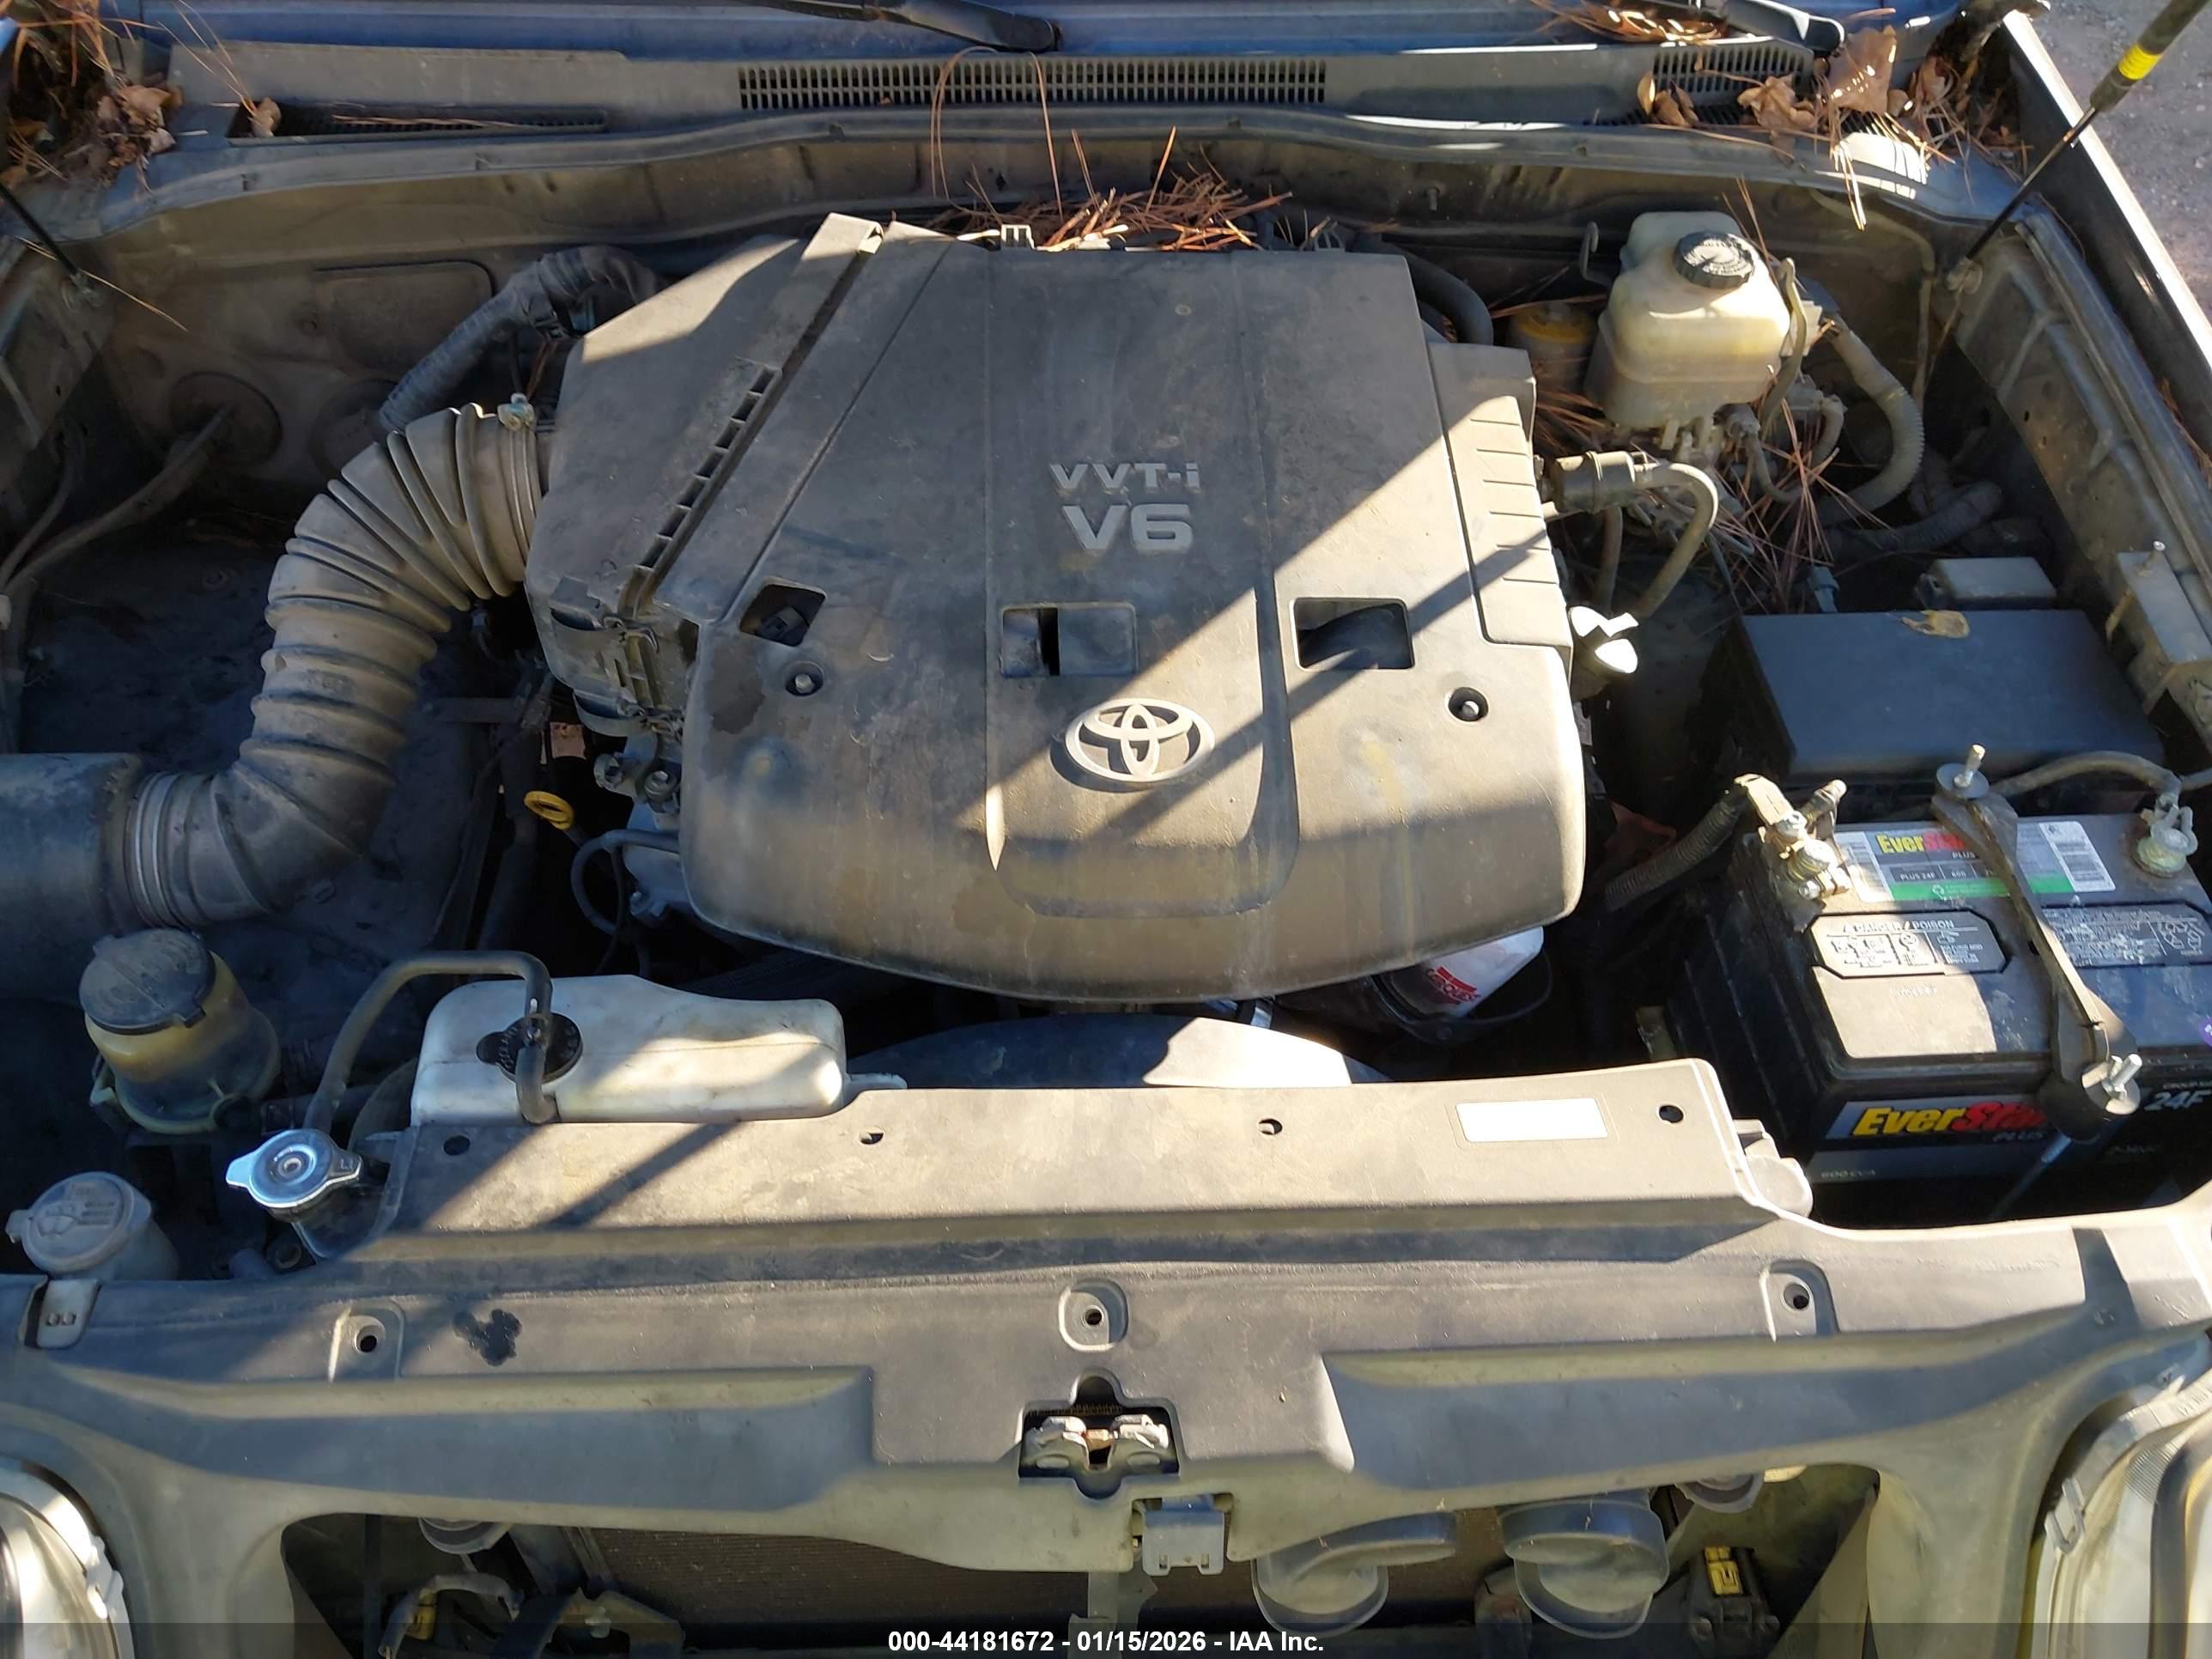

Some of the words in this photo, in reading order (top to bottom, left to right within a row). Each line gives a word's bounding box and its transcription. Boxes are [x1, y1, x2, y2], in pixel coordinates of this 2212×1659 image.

[1049, 462, 1201, 489] VVT-i
[1062, 502, 1194, 552] V6
[1912, 919, 1954, 930] POISON
[2143, 1090, 2212, 1111] 24F
[1852, 1101, 2049, 1138] EverSta
